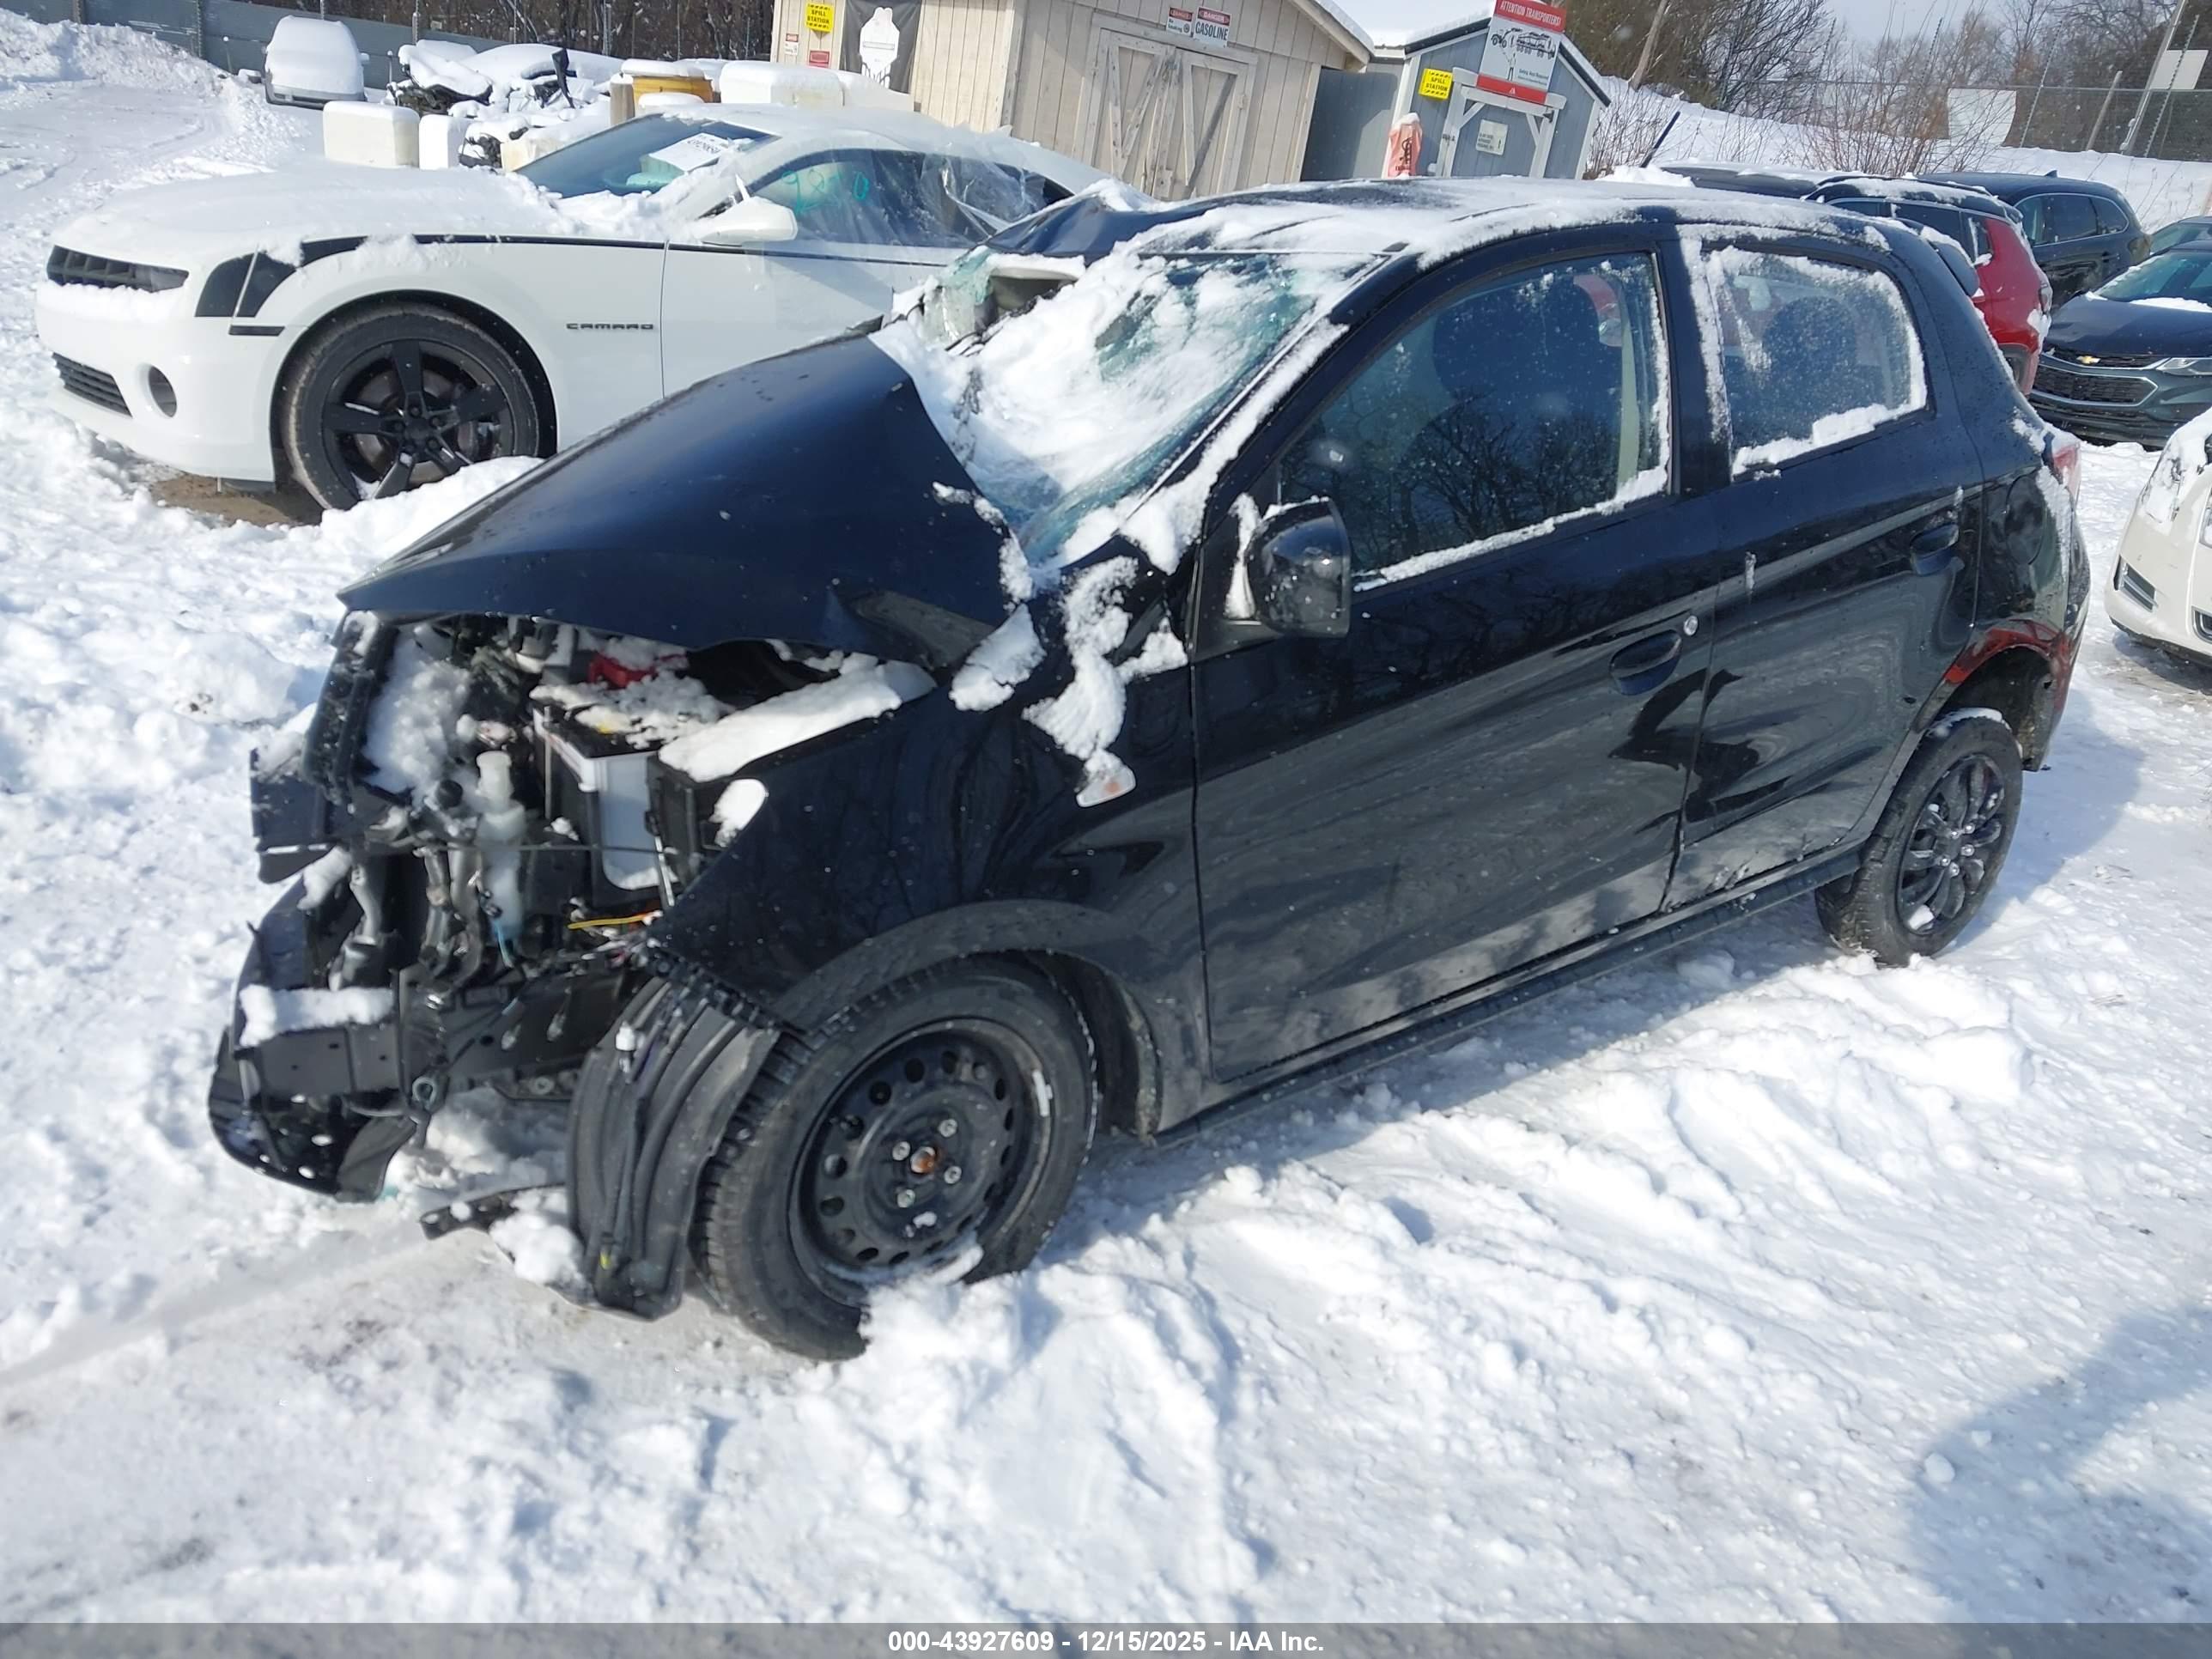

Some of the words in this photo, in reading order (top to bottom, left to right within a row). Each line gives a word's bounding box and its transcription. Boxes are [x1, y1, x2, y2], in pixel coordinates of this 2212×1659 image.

[1499, 1, 1526, 15] ATTENTION
[807, 15, 830, 24] STATION
[1195, 21, 1229, 40] GASOLINE
[1425, 82, 1448, 91] STATION
